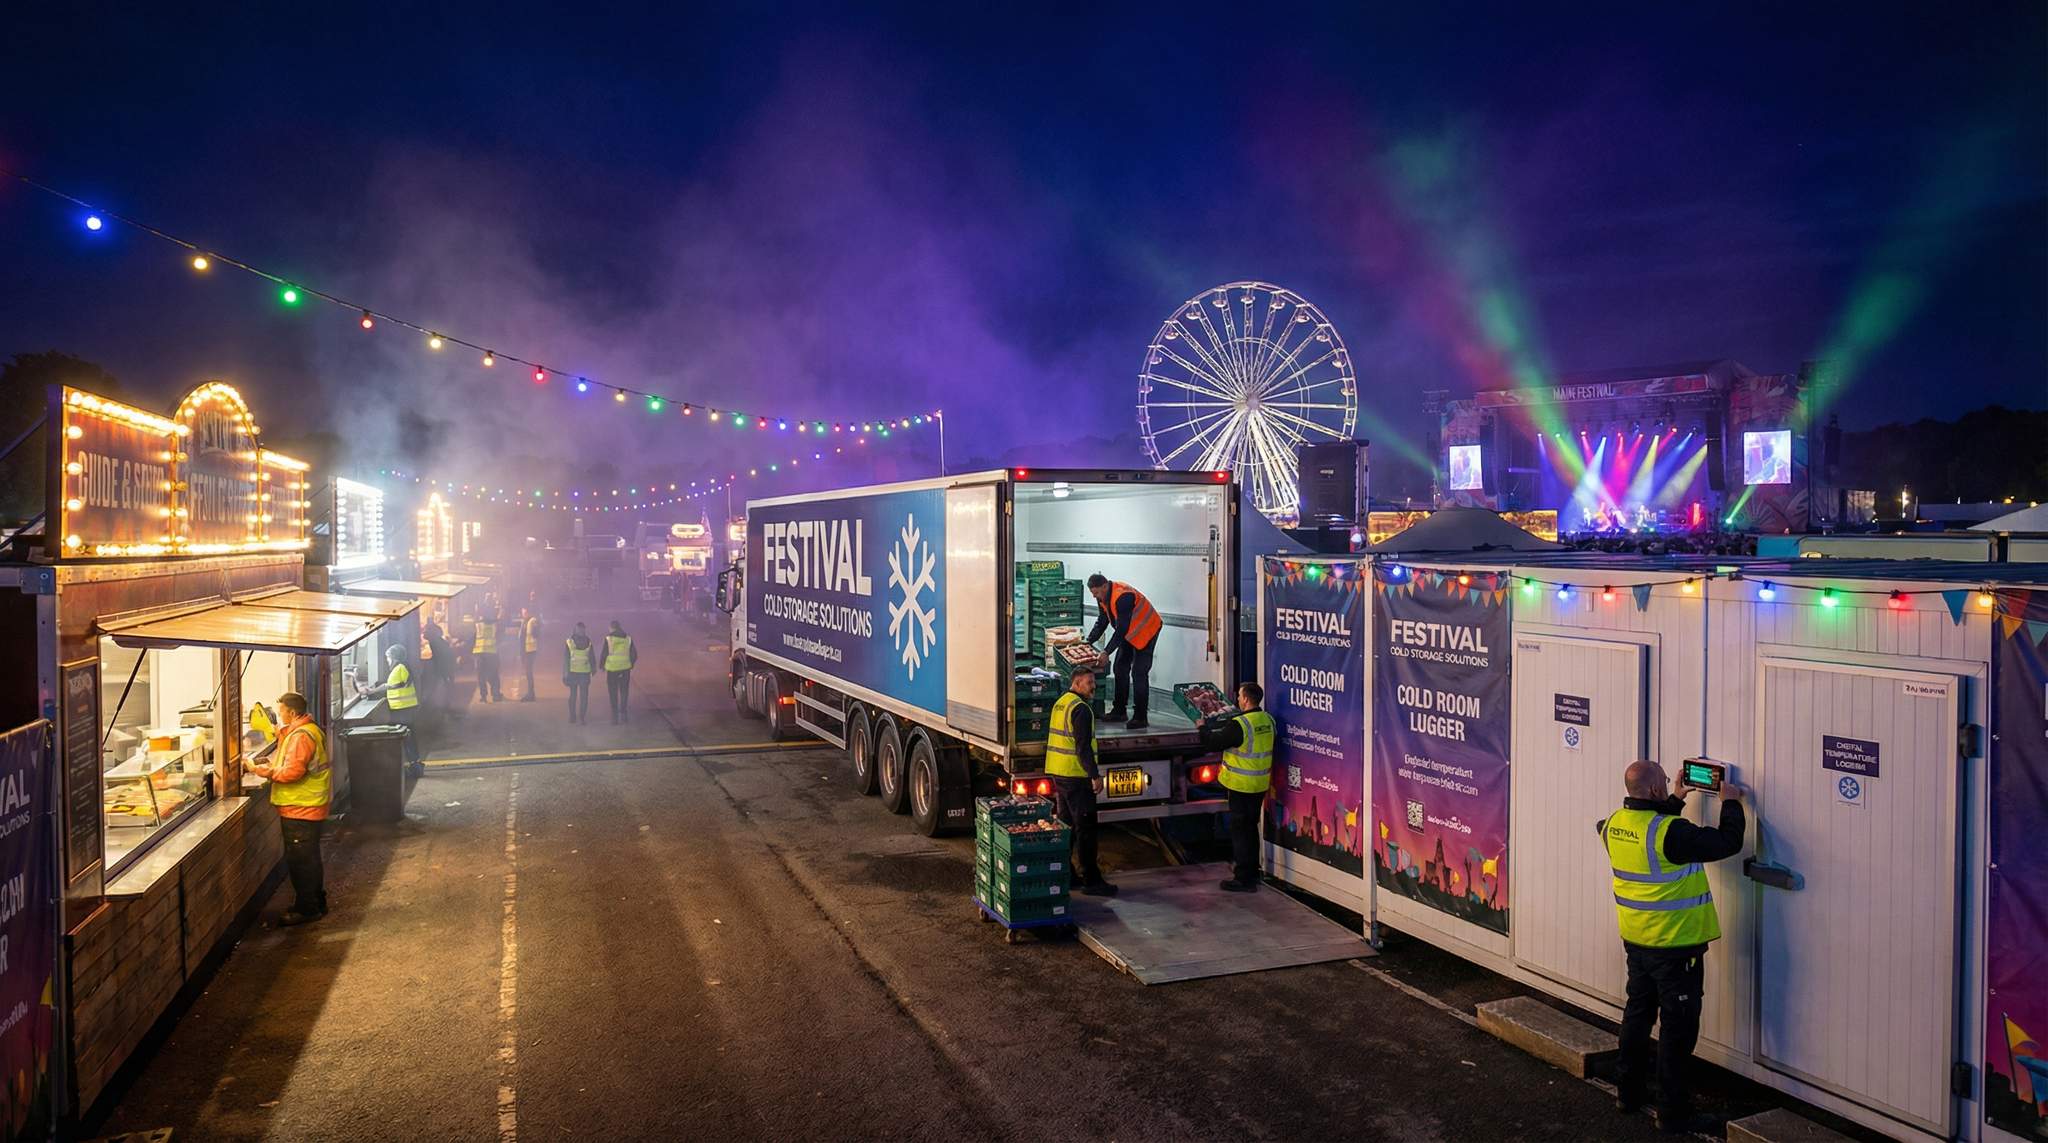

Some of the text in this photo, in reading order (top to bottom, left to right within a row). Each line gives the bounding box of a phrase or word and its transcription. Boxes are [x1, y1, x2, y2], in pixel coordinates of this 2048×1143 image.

[763, 519, 872, 596] FESTIVAL
[764, 593, 873, 639] COLD STORAGE SOLUTIONS
[1276, 607, 1351, 635] FESTIVAL
[1391, 619, 1488, 653] FESTIVAL
[1390, 646, 1409, 657] COLD
[1410, 648, 1443, 662] STORAGE
[1281, 664, 1345, 693] COLD ROOM
[1290, 687, 1333, 713] LUGGER
[1397, 684, 1480, 719] COLD ROOM
[1410, 712, 1465, 741] LUGGER
